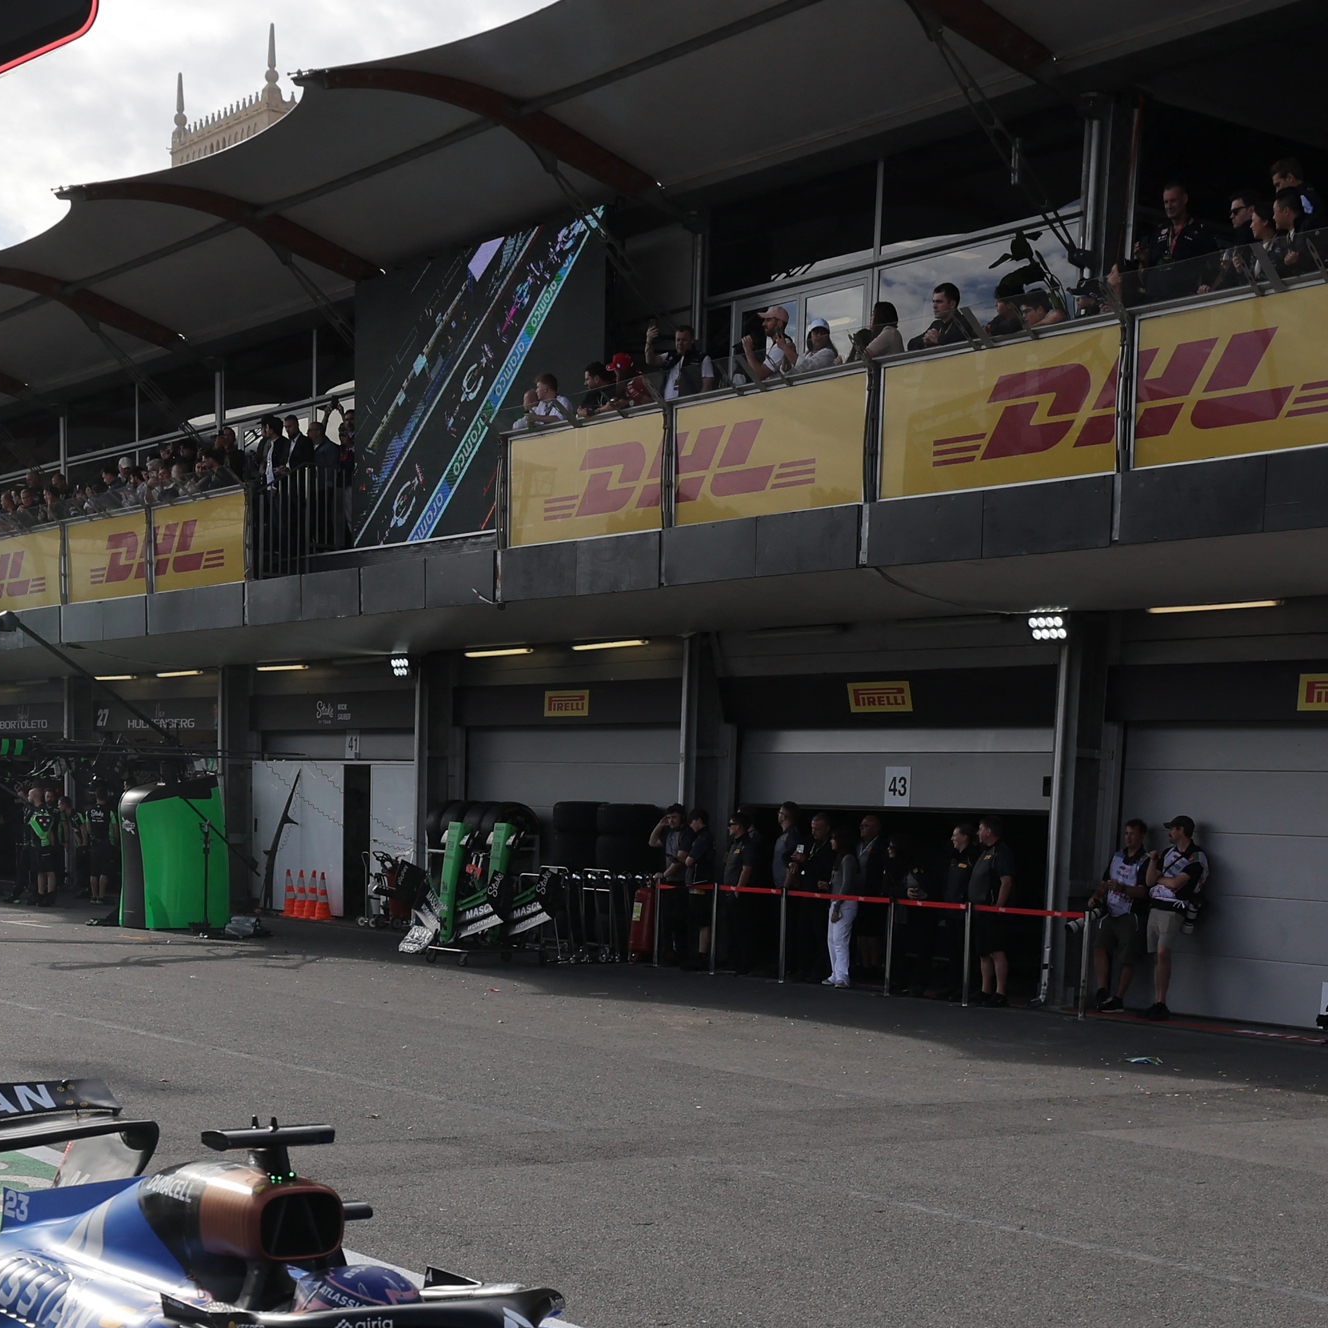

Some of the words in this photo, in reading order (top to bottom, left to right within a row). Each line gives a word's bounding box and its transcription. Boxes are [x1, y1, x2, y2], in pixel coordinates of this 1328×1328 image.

[530, 279, 557, 327] aramco
[495, 341, 526, 397] aramco
[981, 326, 1295, 461] DHL
[575, 418, 776, 517] DHL
[105, 519, 205, 584] DHL
[316, 700, 334, 719] Stake
[548, 695, 585, 711] PIRELLI
[853, 687, 907, 707] PIRELLI
[0, 719, 48, 730] BORTOLETO
[96, 708, 110, 727] 27
[337, 712, 351, 721] SAUBER
[347, 736, 359, 751] 41
[888, 776, 908, 798] 43
[487, 871, 505, 897] Stake
[536, 869, 552, 895] Stake
[147, 1175, 193, 1204] DURACELL
[4, 1189, 30, 1222] 23
[319, 1285, 366, 1310] ATLASSI
